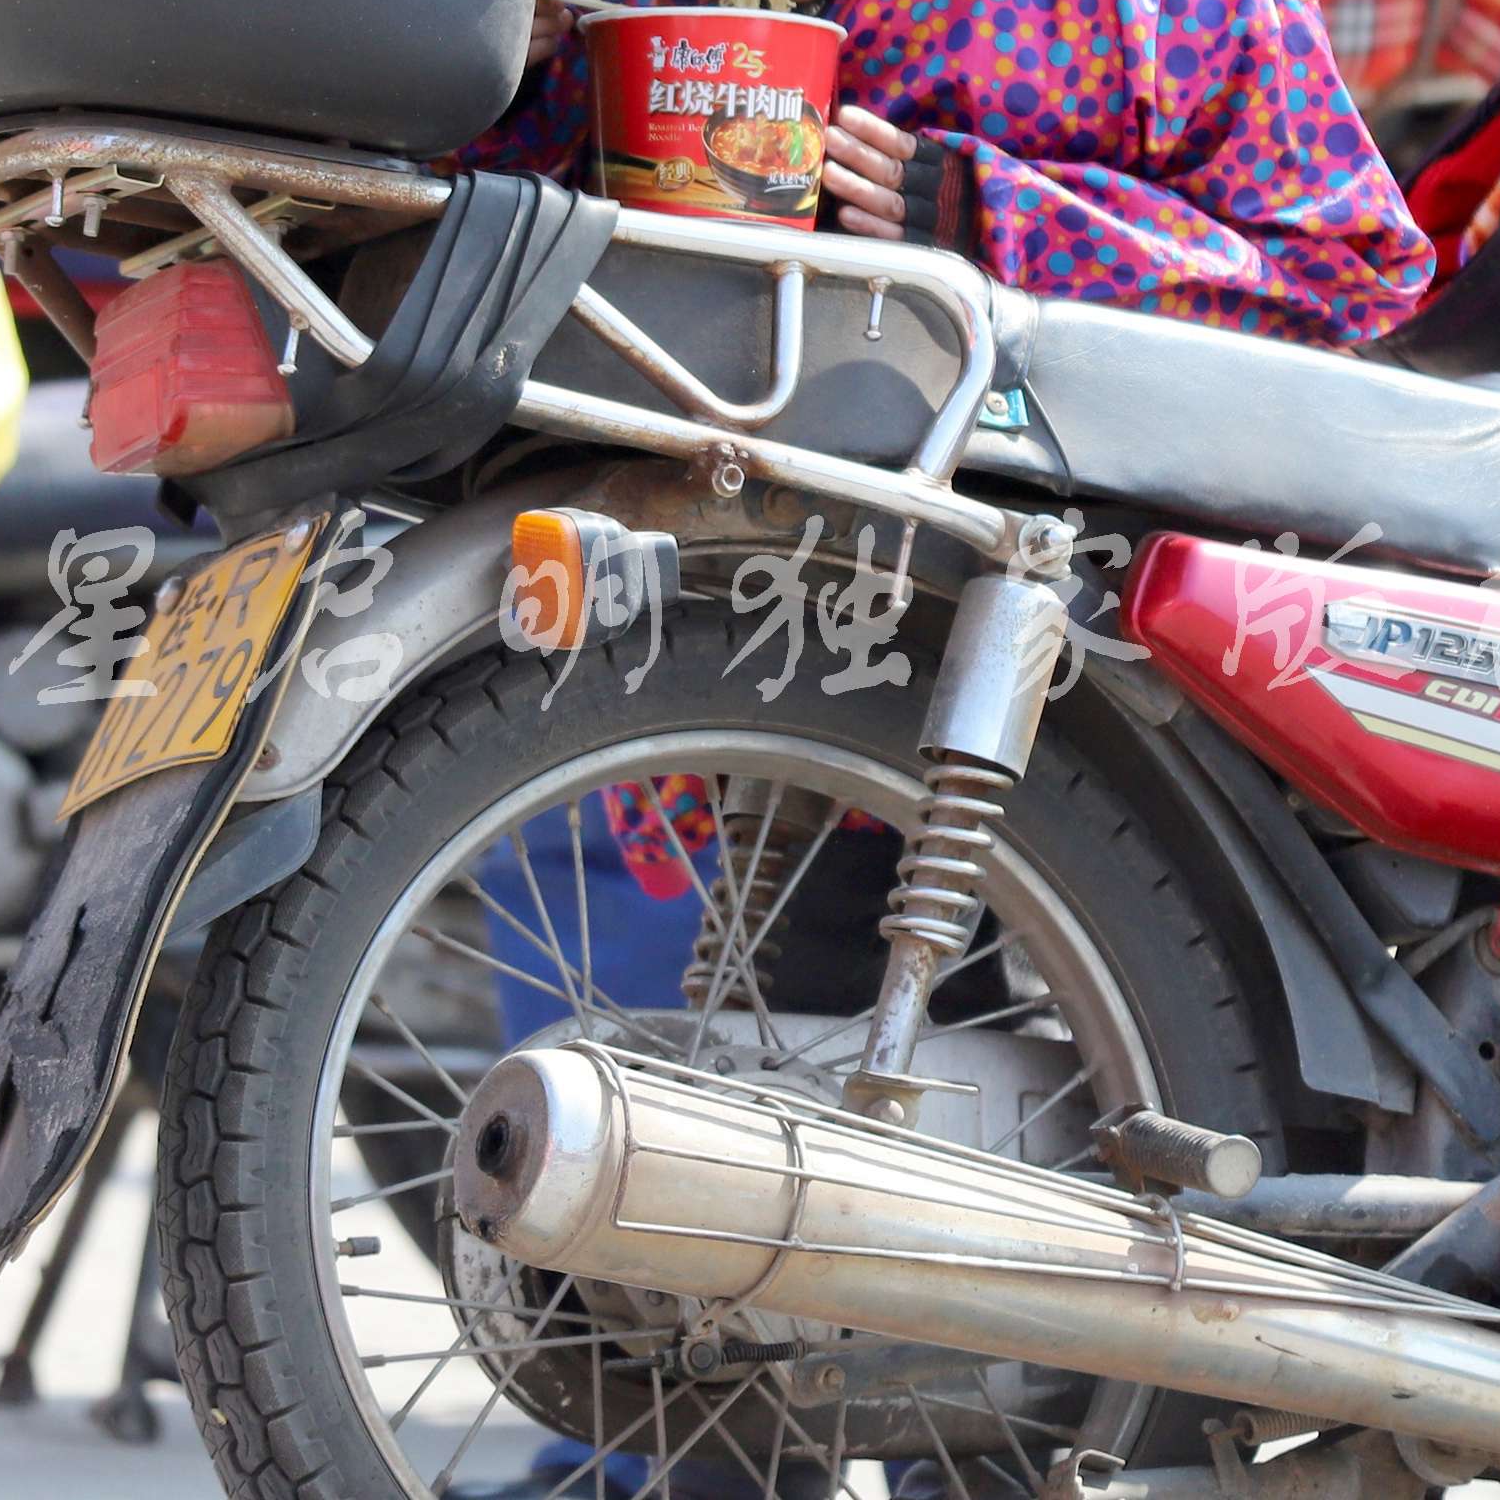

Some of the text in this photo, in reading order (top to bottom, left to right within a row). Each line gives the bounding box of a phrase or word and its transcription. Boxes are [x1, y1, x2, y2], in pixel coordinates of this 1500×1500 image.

[671, 38, 728, 73] 康师傅
[648, 79, 804, 122] 红烧牛肉面
[659, 163, 691, 180] 经典
